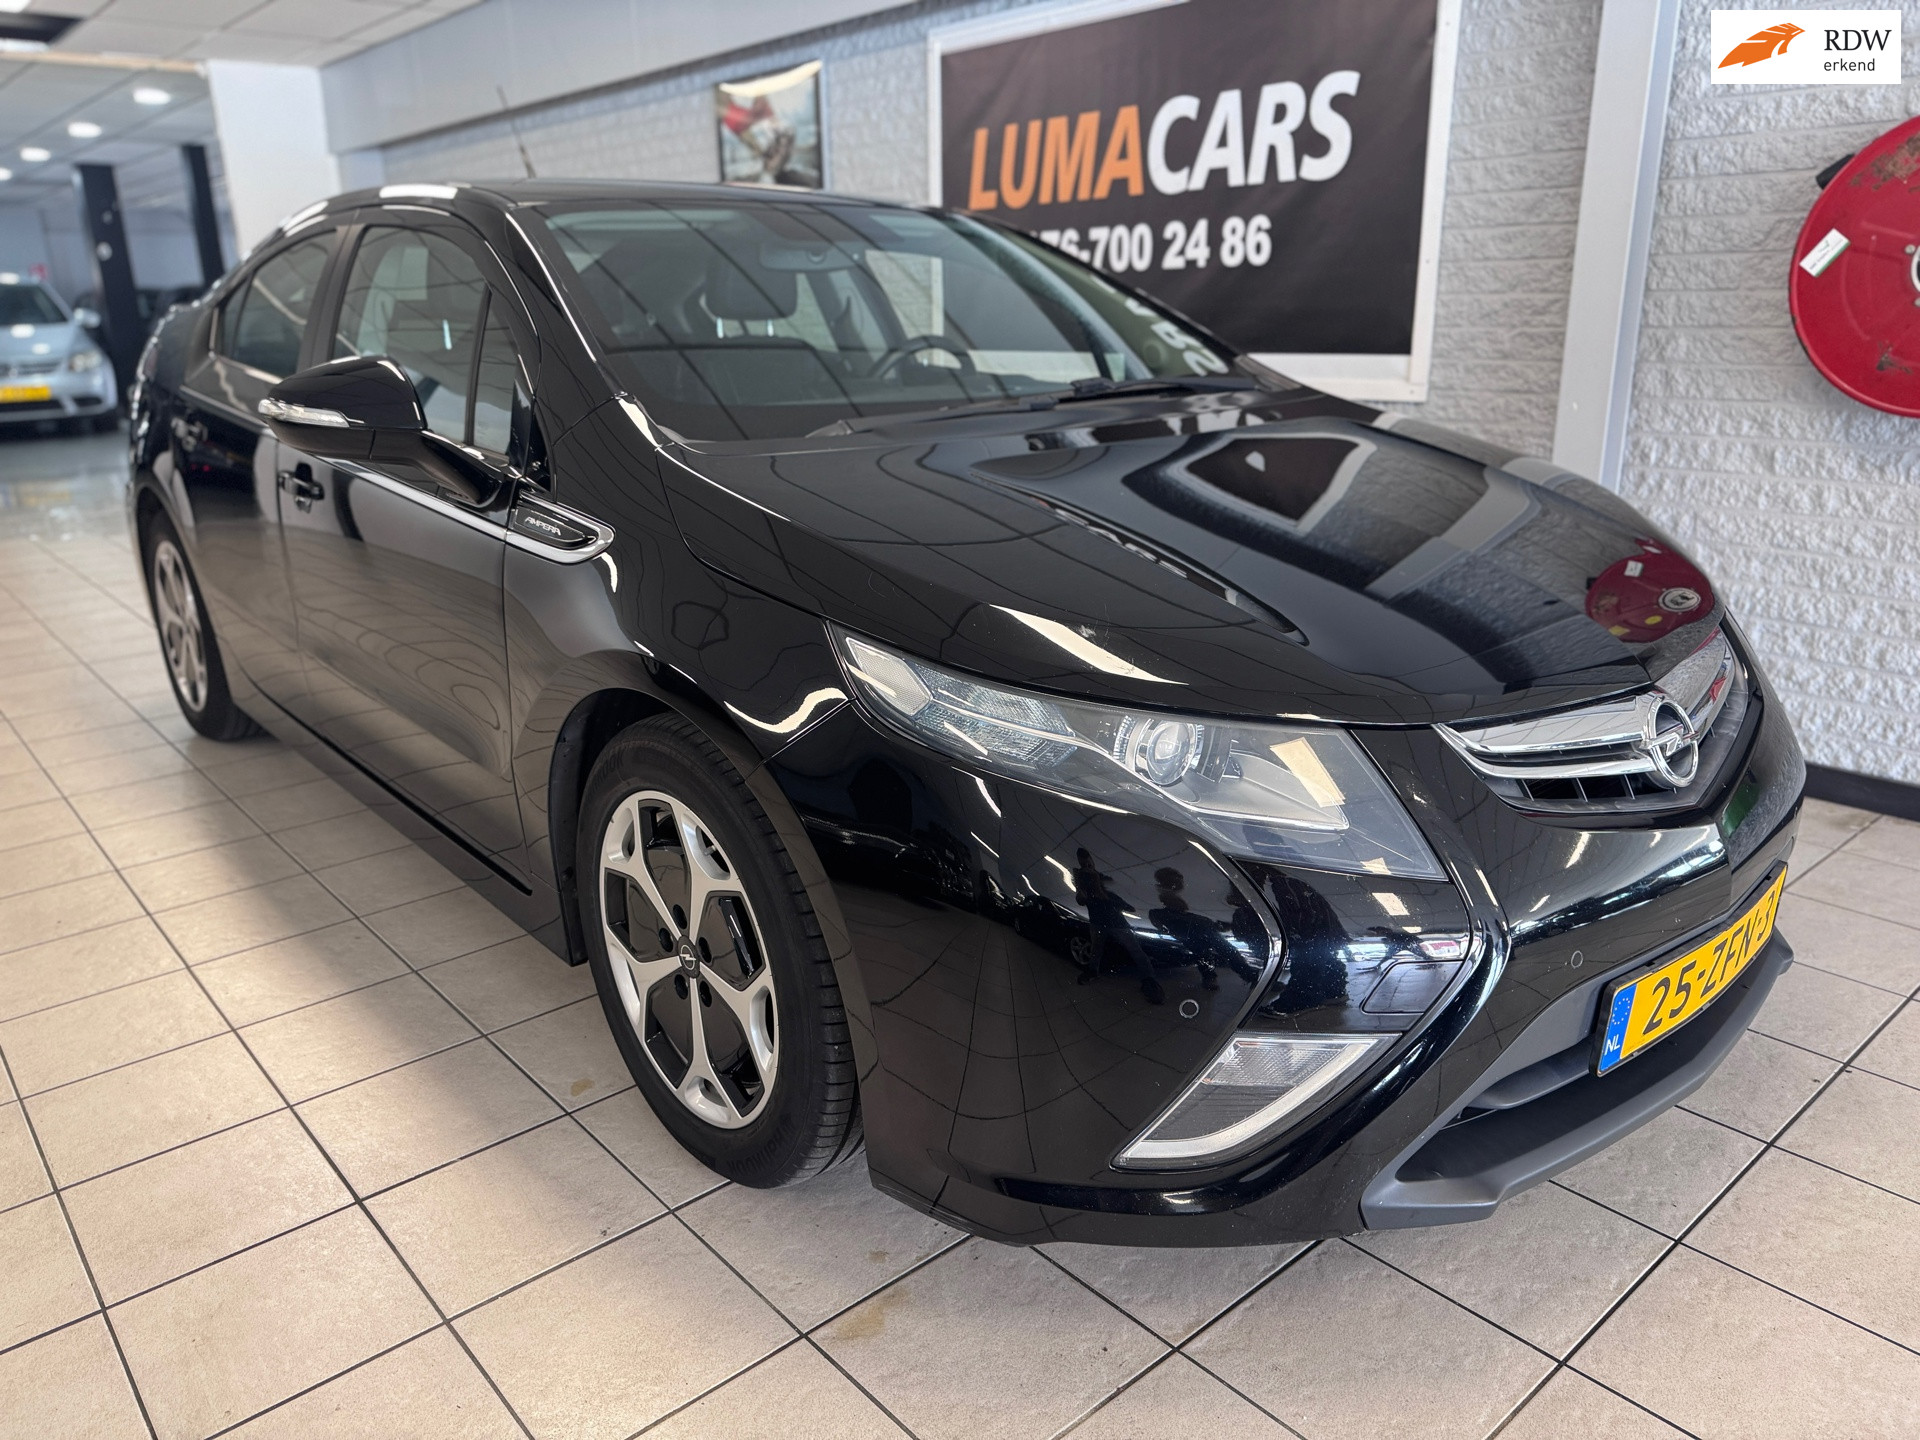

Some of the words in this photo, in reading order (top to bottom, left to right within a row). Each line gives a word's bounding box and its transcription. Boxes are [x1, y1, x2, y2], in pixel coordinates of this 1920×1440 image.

[968, 70, 1361, 211] LUMACARS
[1161, 219, 1210, 270] 24
[1219, 214, 1272, 268] 86
[524, 516, 562, 536] AMPERA
[1643, 890, 1775, 1035] 25-ZFN-3
[1604, 1034, 1621, 1056] NL
